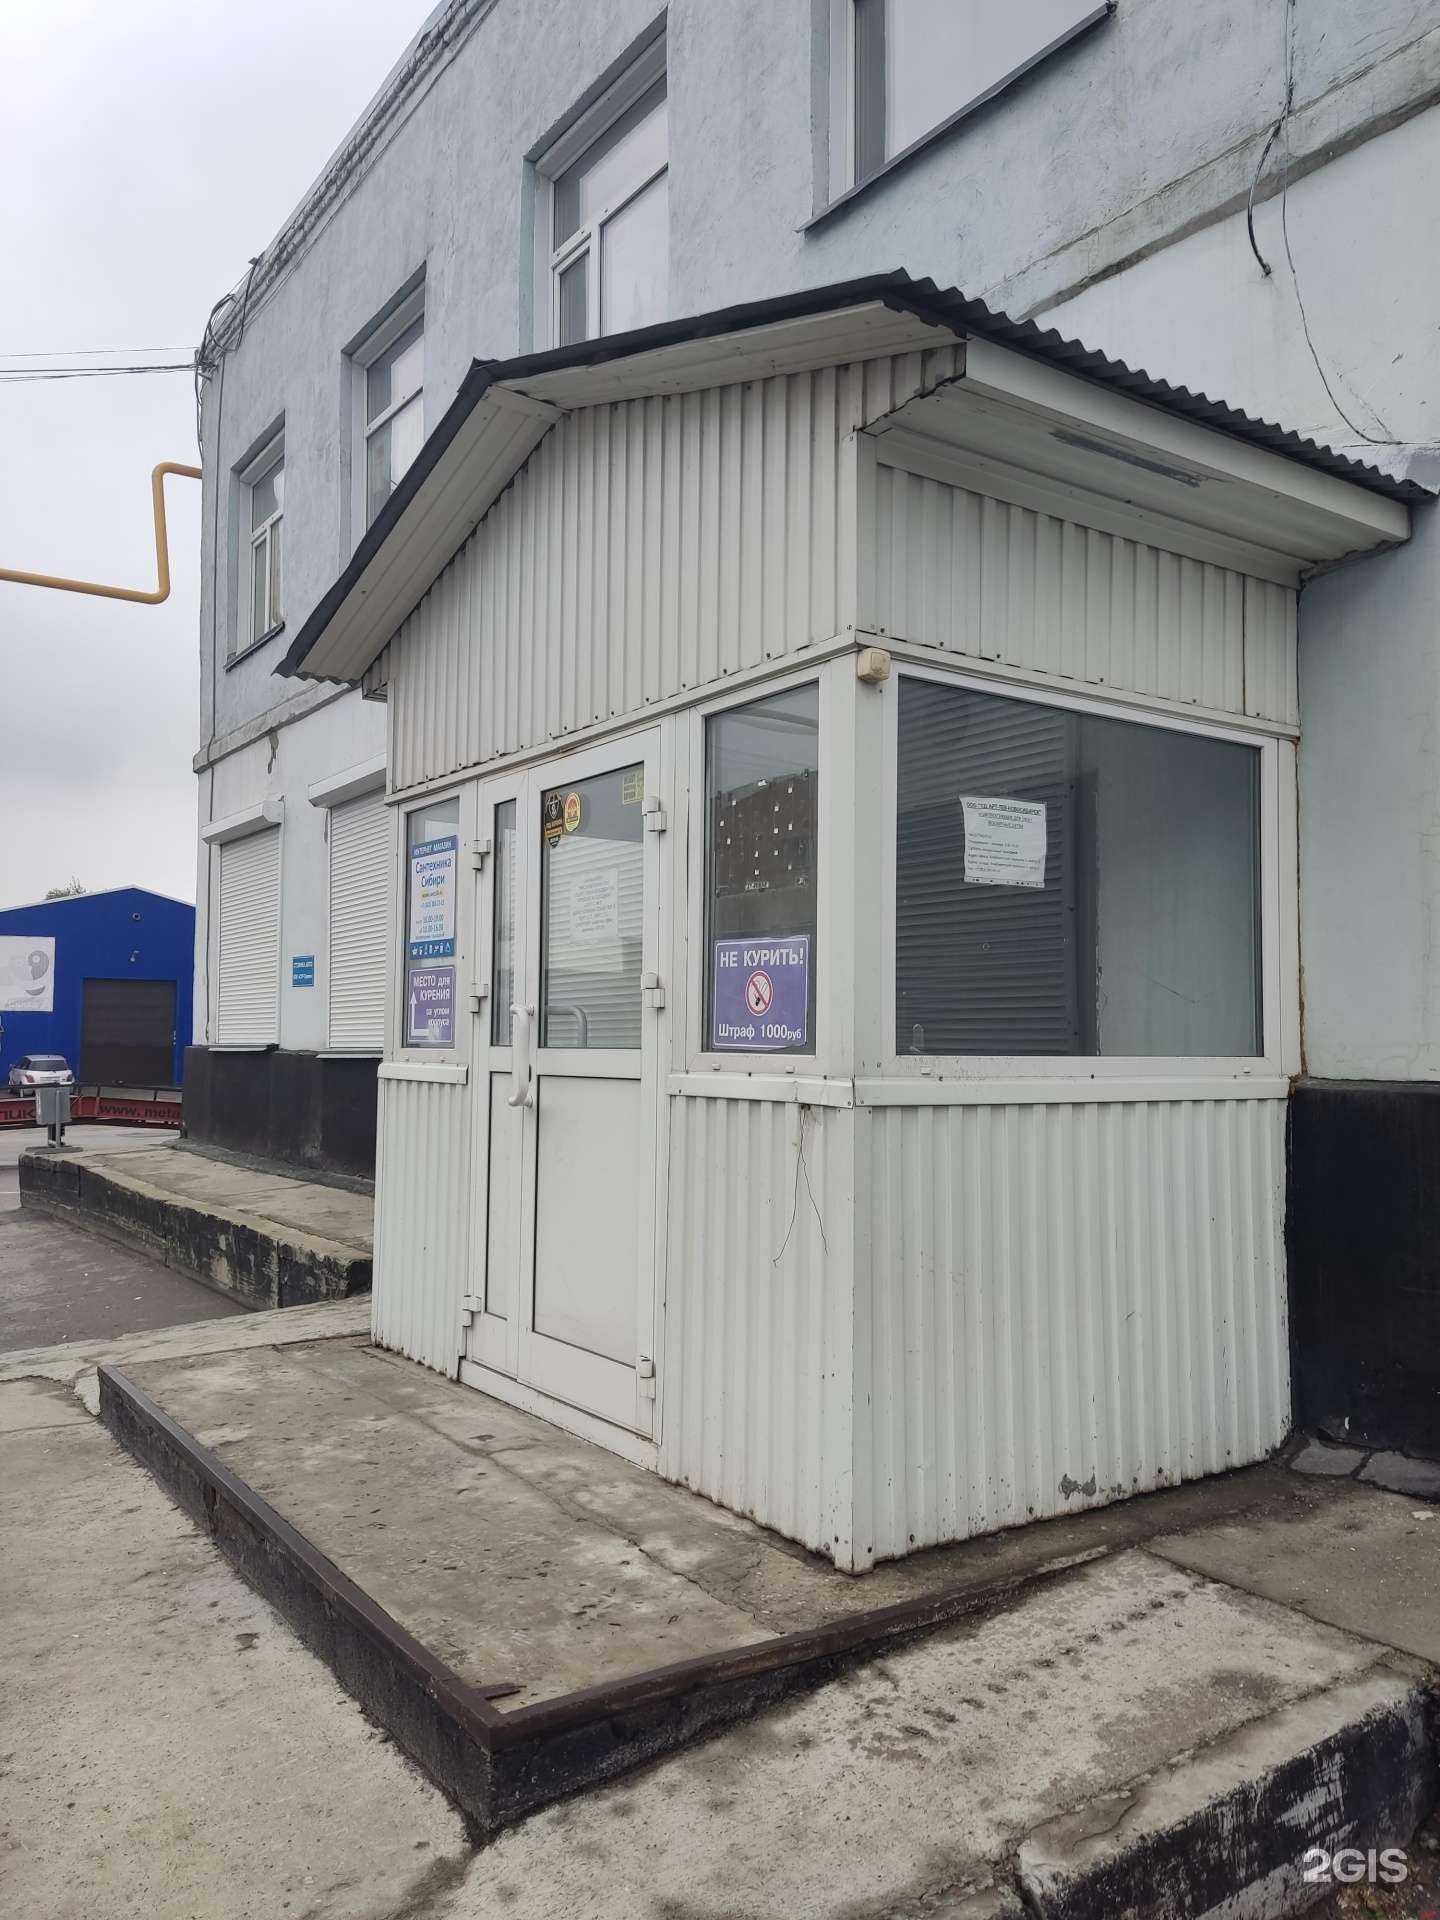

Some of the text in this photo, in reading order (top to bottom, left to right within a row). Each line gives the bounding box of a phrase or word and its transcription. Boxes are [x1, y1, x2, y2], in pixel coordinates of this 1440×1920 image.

[415, 858, 452, 874] Сантехника
[421, 873, 445, 889] Сибири
[720, 947, 804, 968] НЕ КУРИТЬ!
[413, 975, 436, 987] МЕСТО
[419, 989, 450, 1001] КУРЕНИЯ
[718, 1023, 802, 1040] Штраф 1000руб
